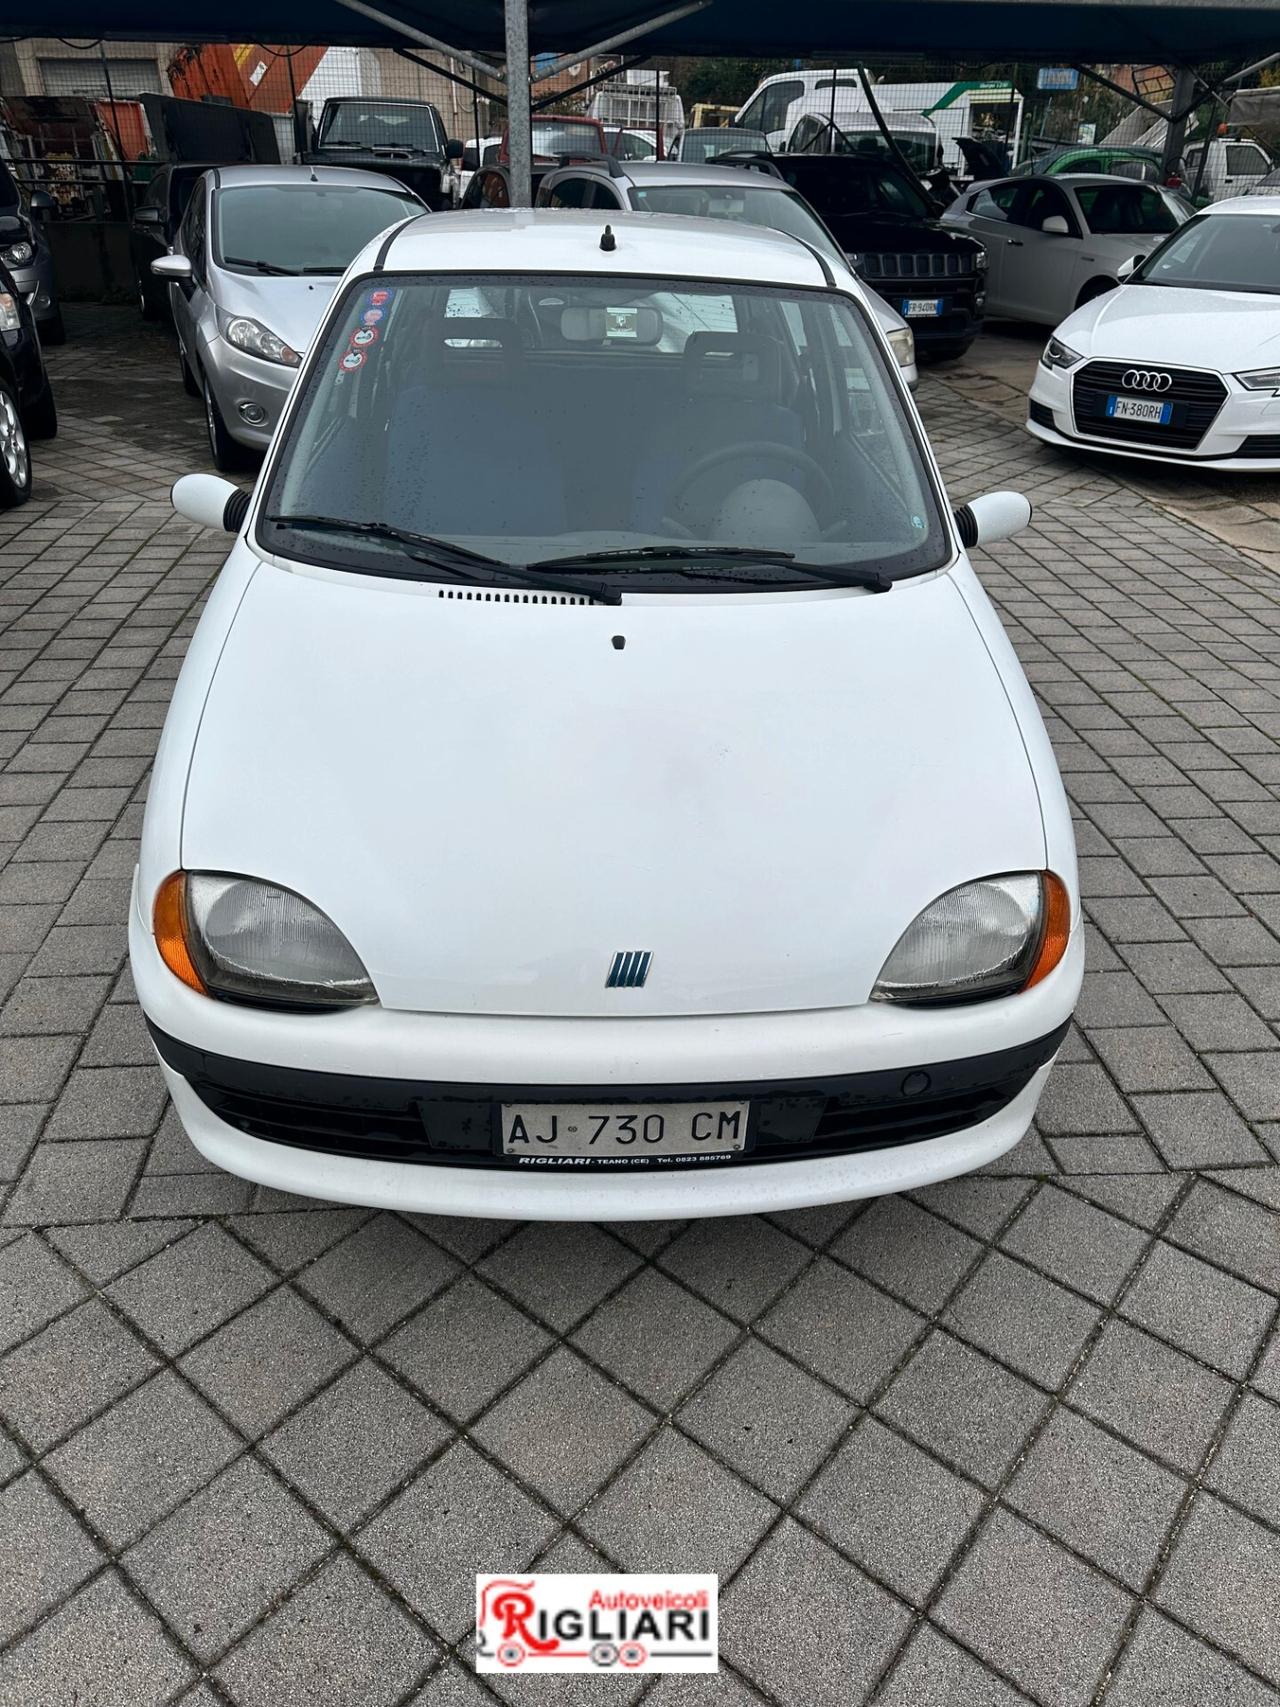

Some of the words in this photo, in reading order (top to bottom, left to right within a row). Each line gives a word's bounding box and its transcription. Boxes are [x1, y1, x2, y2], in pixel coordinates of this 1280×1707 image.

[508, 1115, 558, 1144] AJ
[588, 1114, 664, 1145] 730
[691, 1111, 742, 1141] CM
